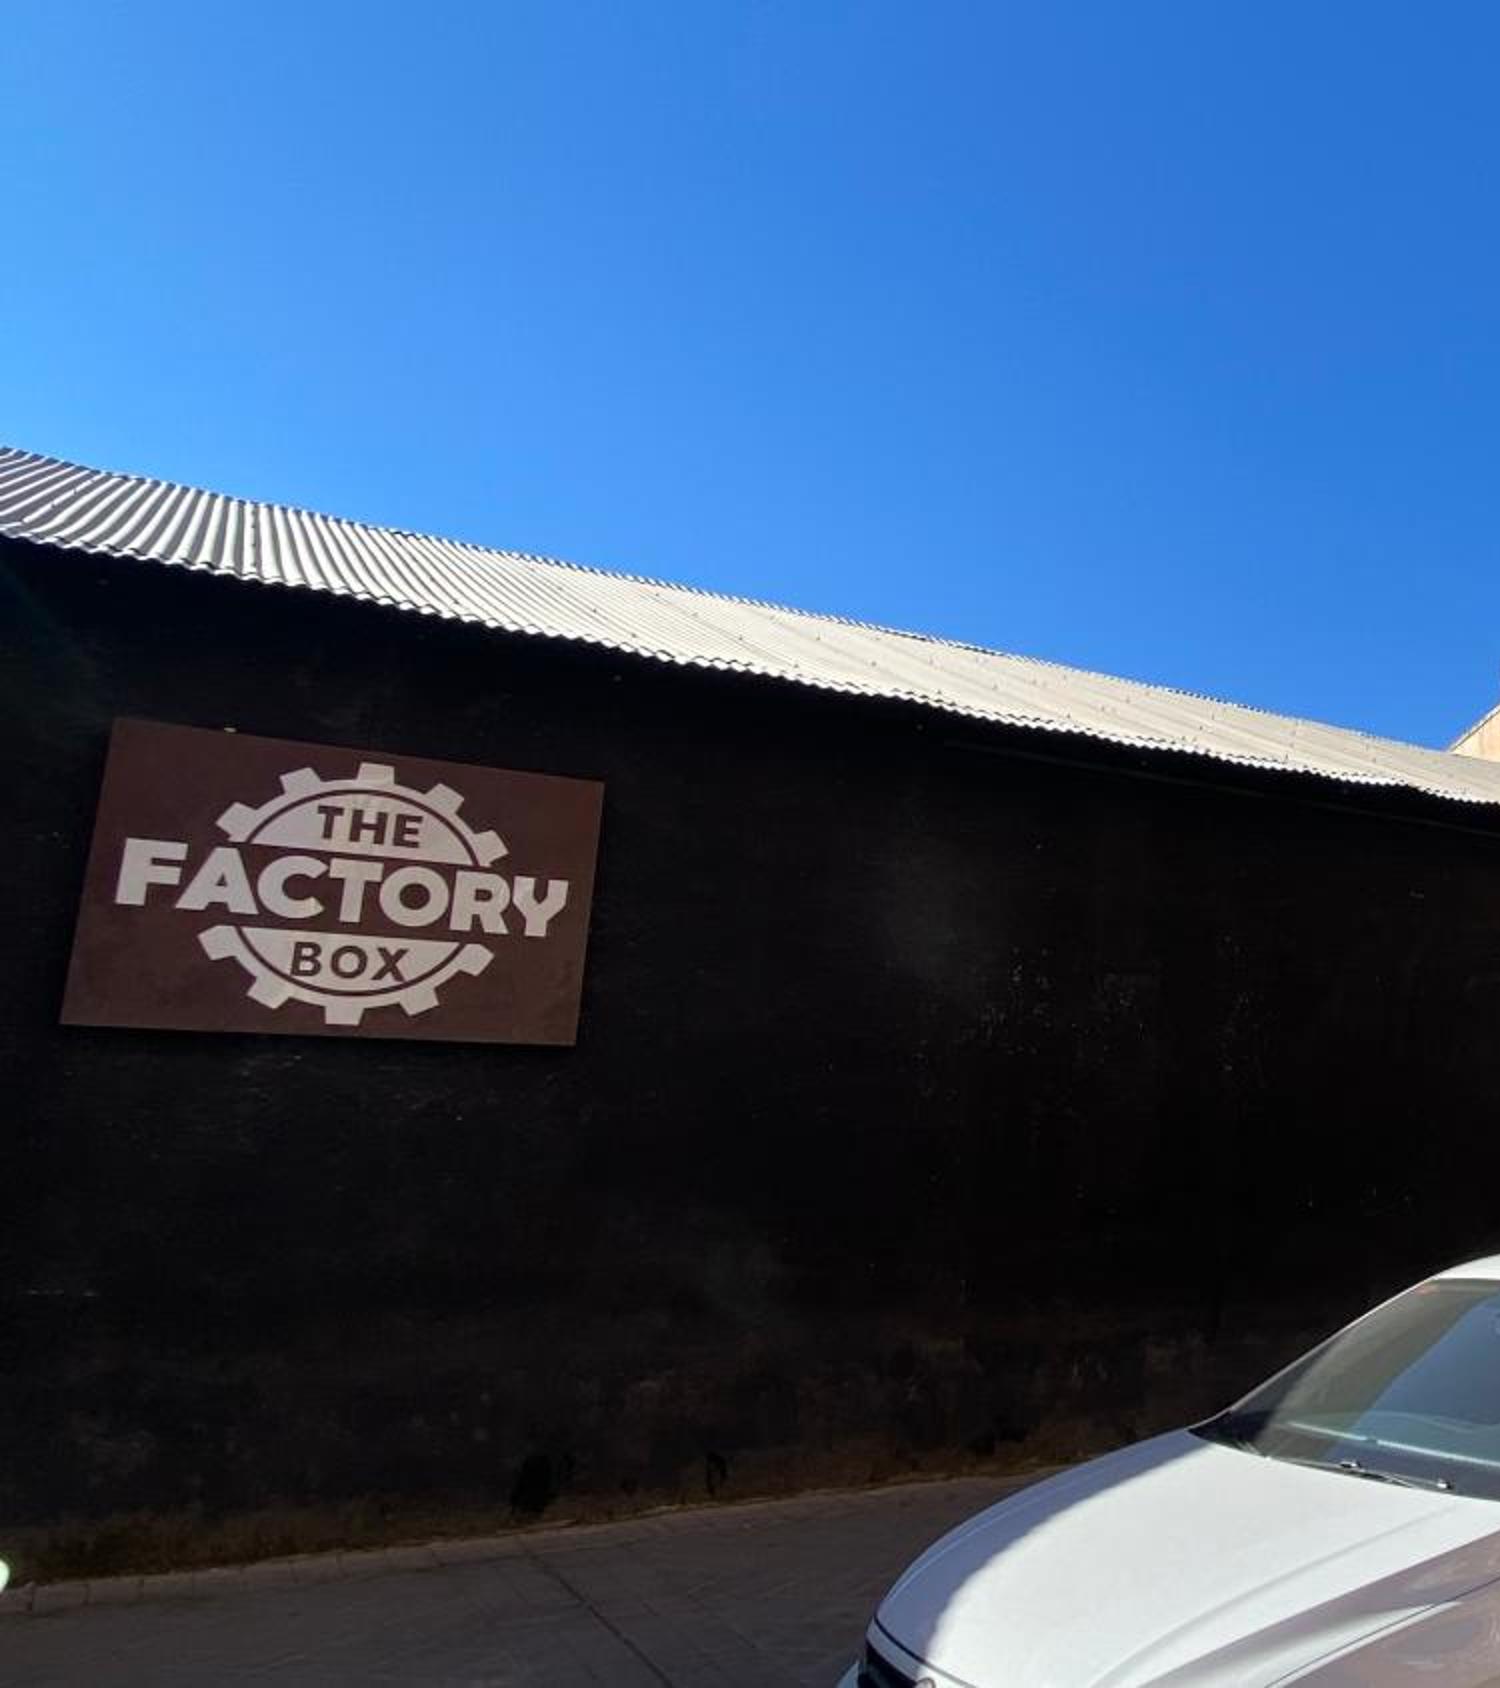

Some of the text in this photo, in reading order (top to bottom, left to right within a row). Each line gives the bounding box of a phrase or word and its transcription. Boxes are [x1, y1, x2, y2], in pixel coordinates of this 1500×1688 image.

[316, 805, 424, 848] THE
[115, 837, 569, 937] FACTORY
[290, 941, 408, 981] BOX
